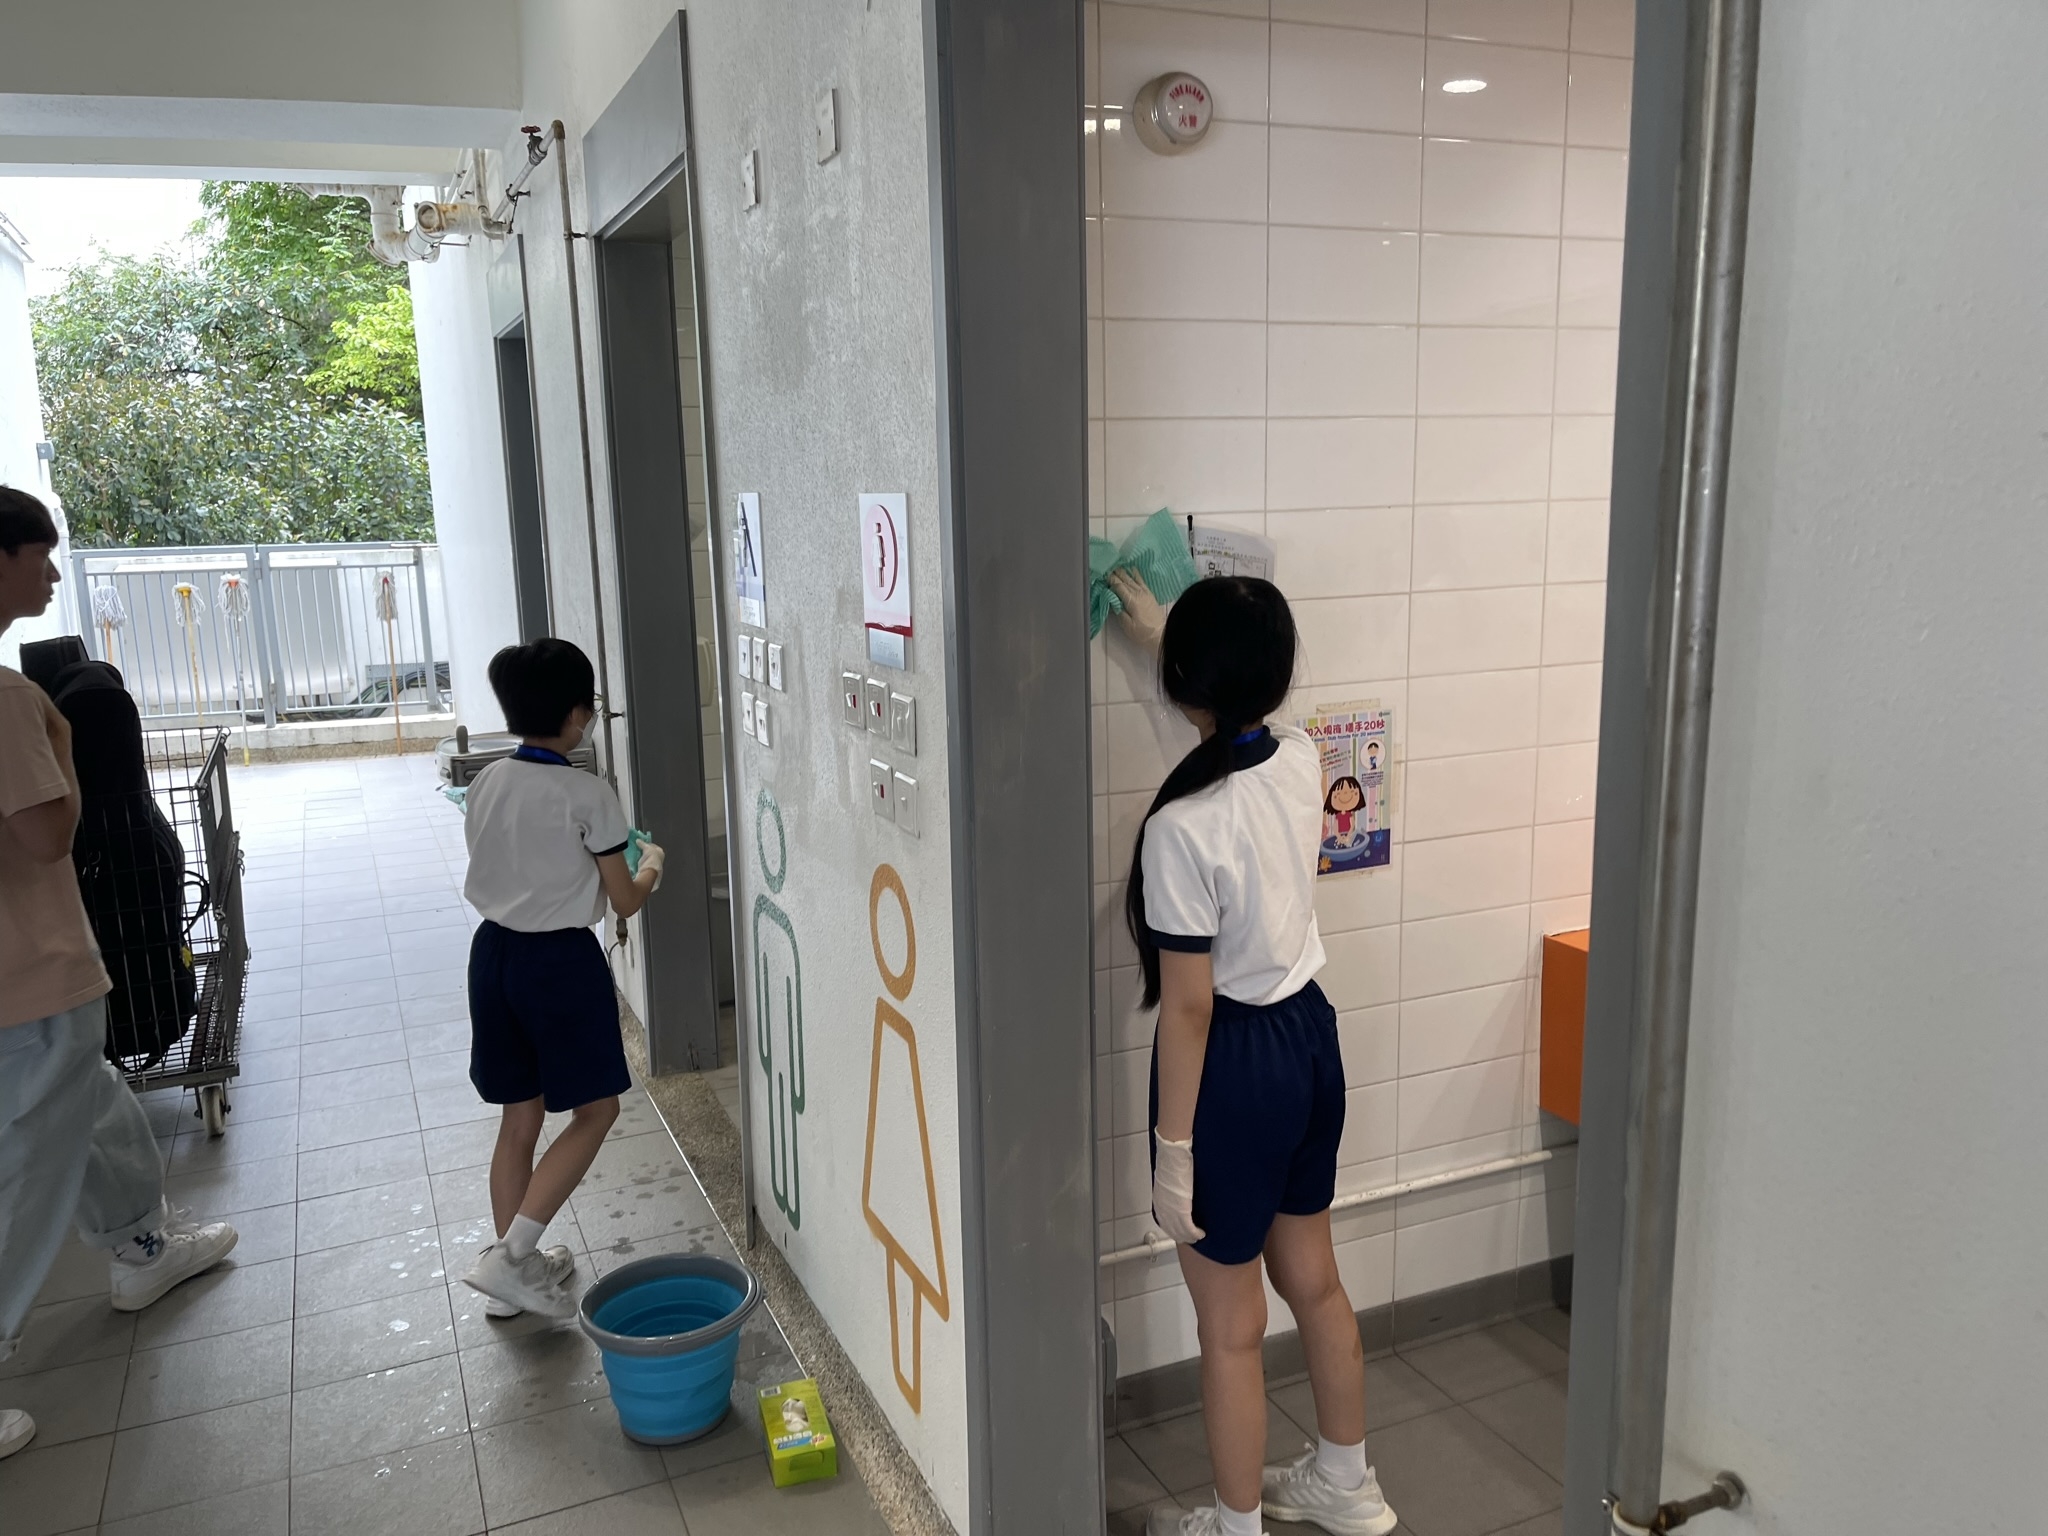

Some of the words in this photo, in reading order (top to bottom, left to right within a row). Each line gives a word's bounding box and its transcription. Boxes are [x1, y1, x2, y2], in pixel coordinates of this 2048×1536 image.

[1169, 84, 1184, 101] FIRE
[1185, 84, 1205, 104] ALARM
[1179, 114, 1197, 128] 火警
